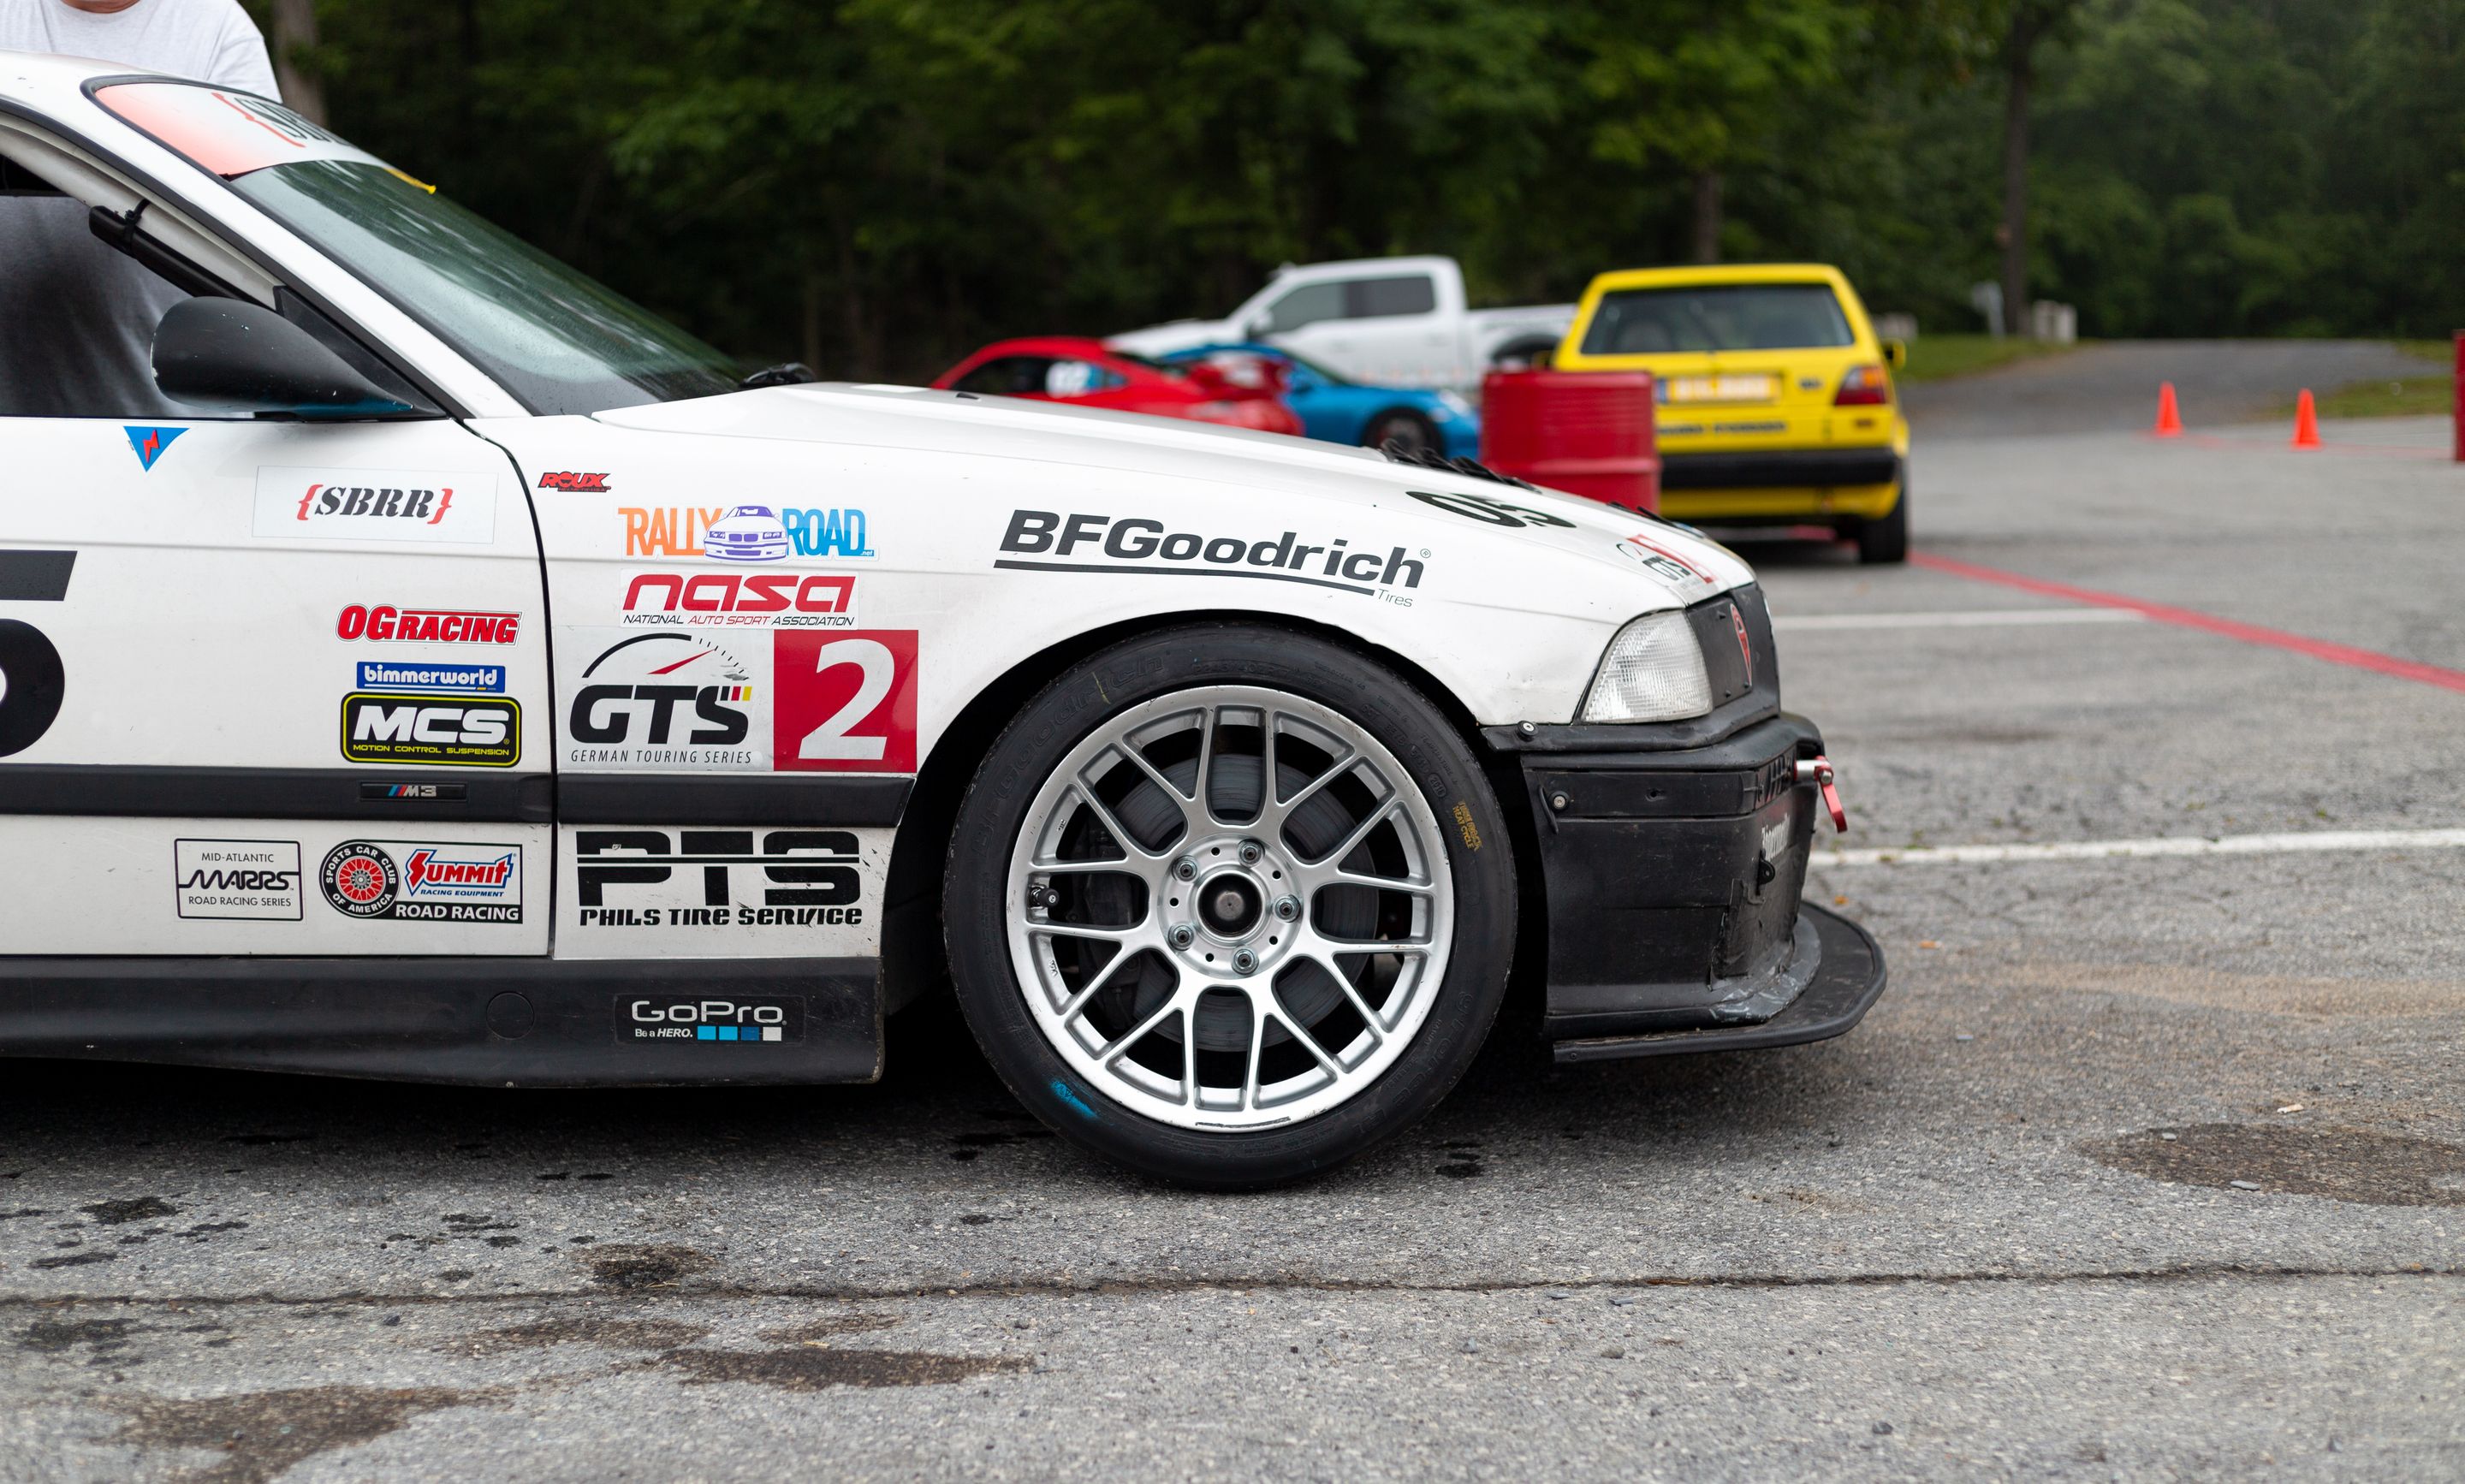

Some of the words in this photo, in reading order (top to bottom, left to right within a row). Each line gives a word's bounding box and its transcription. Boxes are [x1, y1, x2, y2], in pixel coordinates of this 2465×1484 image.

[538, 472, 609, 488] ROUX
[618, 508, 722, 556] RALLY
[782, 508, 867, 557] ROAD
[1000, 509, 1424, 588] BFGoodrich
[1379, 588, 1413, 608] Tires
[623, 614, 684, 625] NATIONAL
[687, 615, 724, 625] AUTO
[727, 615, 770, 626] SPORT
[771, 616, 855, 626] ASSOCIATION
[365, 664, 497, 685] bimmerworld
[798, 638, 894, 760] 2
[353, 705, 509, 745] MCS
[570, 685, 749, 745] GTS
[395, 745, 442, 754] CONTROL
[446, 747, 509, 756] SUSPENSION
[571, 750, 628, 763] GERMAN
[637, 751, 697, 763] TOURING
[704, 751, 751, 763] SERIES
[202, 852, 274, 863] MID-ATLANTIC
[326, 848, 352, 883] SPORTS
[356, 846, 378, 858] CAR
[381, 858, 396, 884] CLUB
[576, 831, 860, 905] PTS
[188, 896, 217, 905] ROAD
[220, 897, 258, 906] RACING
[261, 898, 291, 906] SERIES
[332, 893, 346, 905] OF
[347, 893, 393, 913] AMERICA
[395, 904, 447, 917] ROAD
[451, 906, 519, 920] RACING
[580, 909, 661, 926] PHILS
[632, 1000, 783, 1023] GoPro
[635, 1029, 647, 1037] Be
[656, 1029, 693, 1037] HERO.
